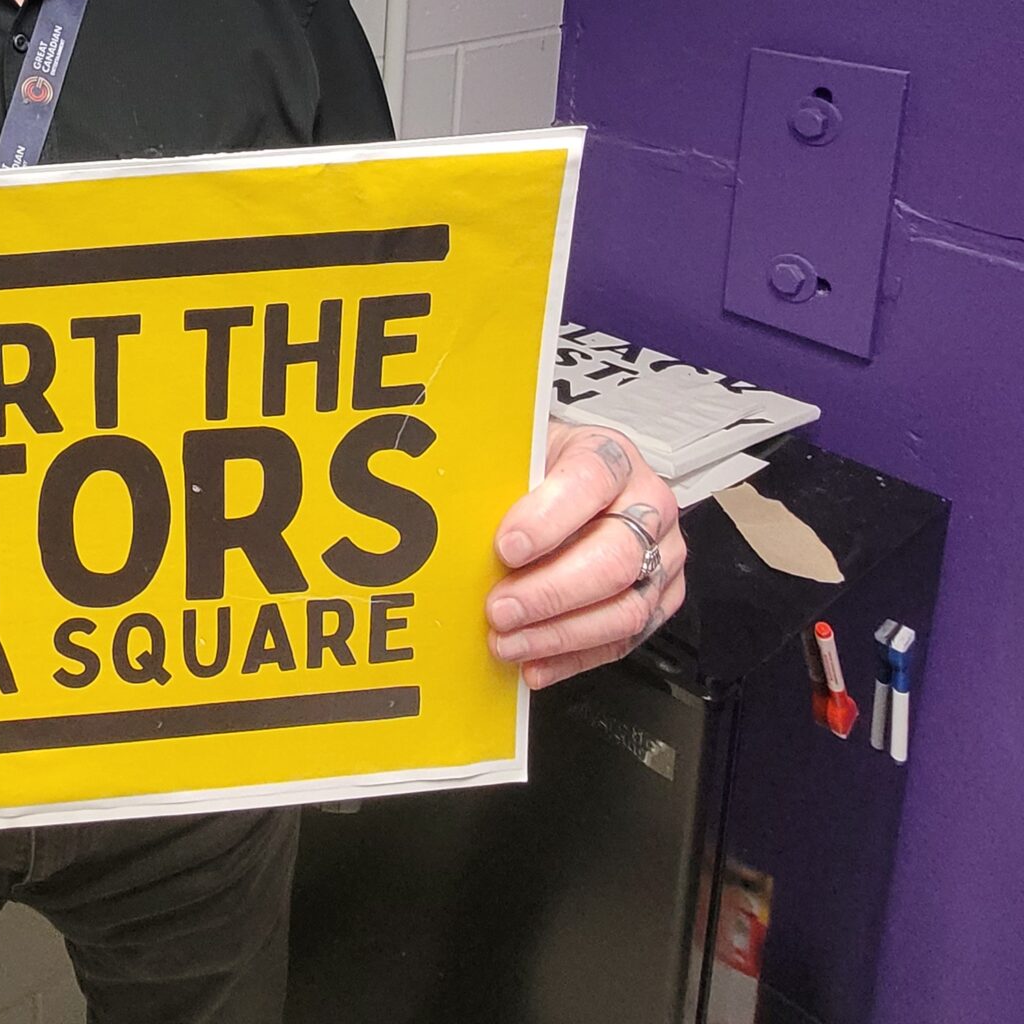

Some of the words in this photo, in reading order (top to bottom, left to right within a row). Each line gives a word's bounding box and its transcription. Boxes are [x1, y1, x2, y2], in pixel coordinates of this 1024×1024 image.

[33, 40, 48, 70] GREAT
[42, 25, 63, 73] CANADIAN
[184, 293, 432, 421] THE
[53, 593, 415, 689] SQUARE
